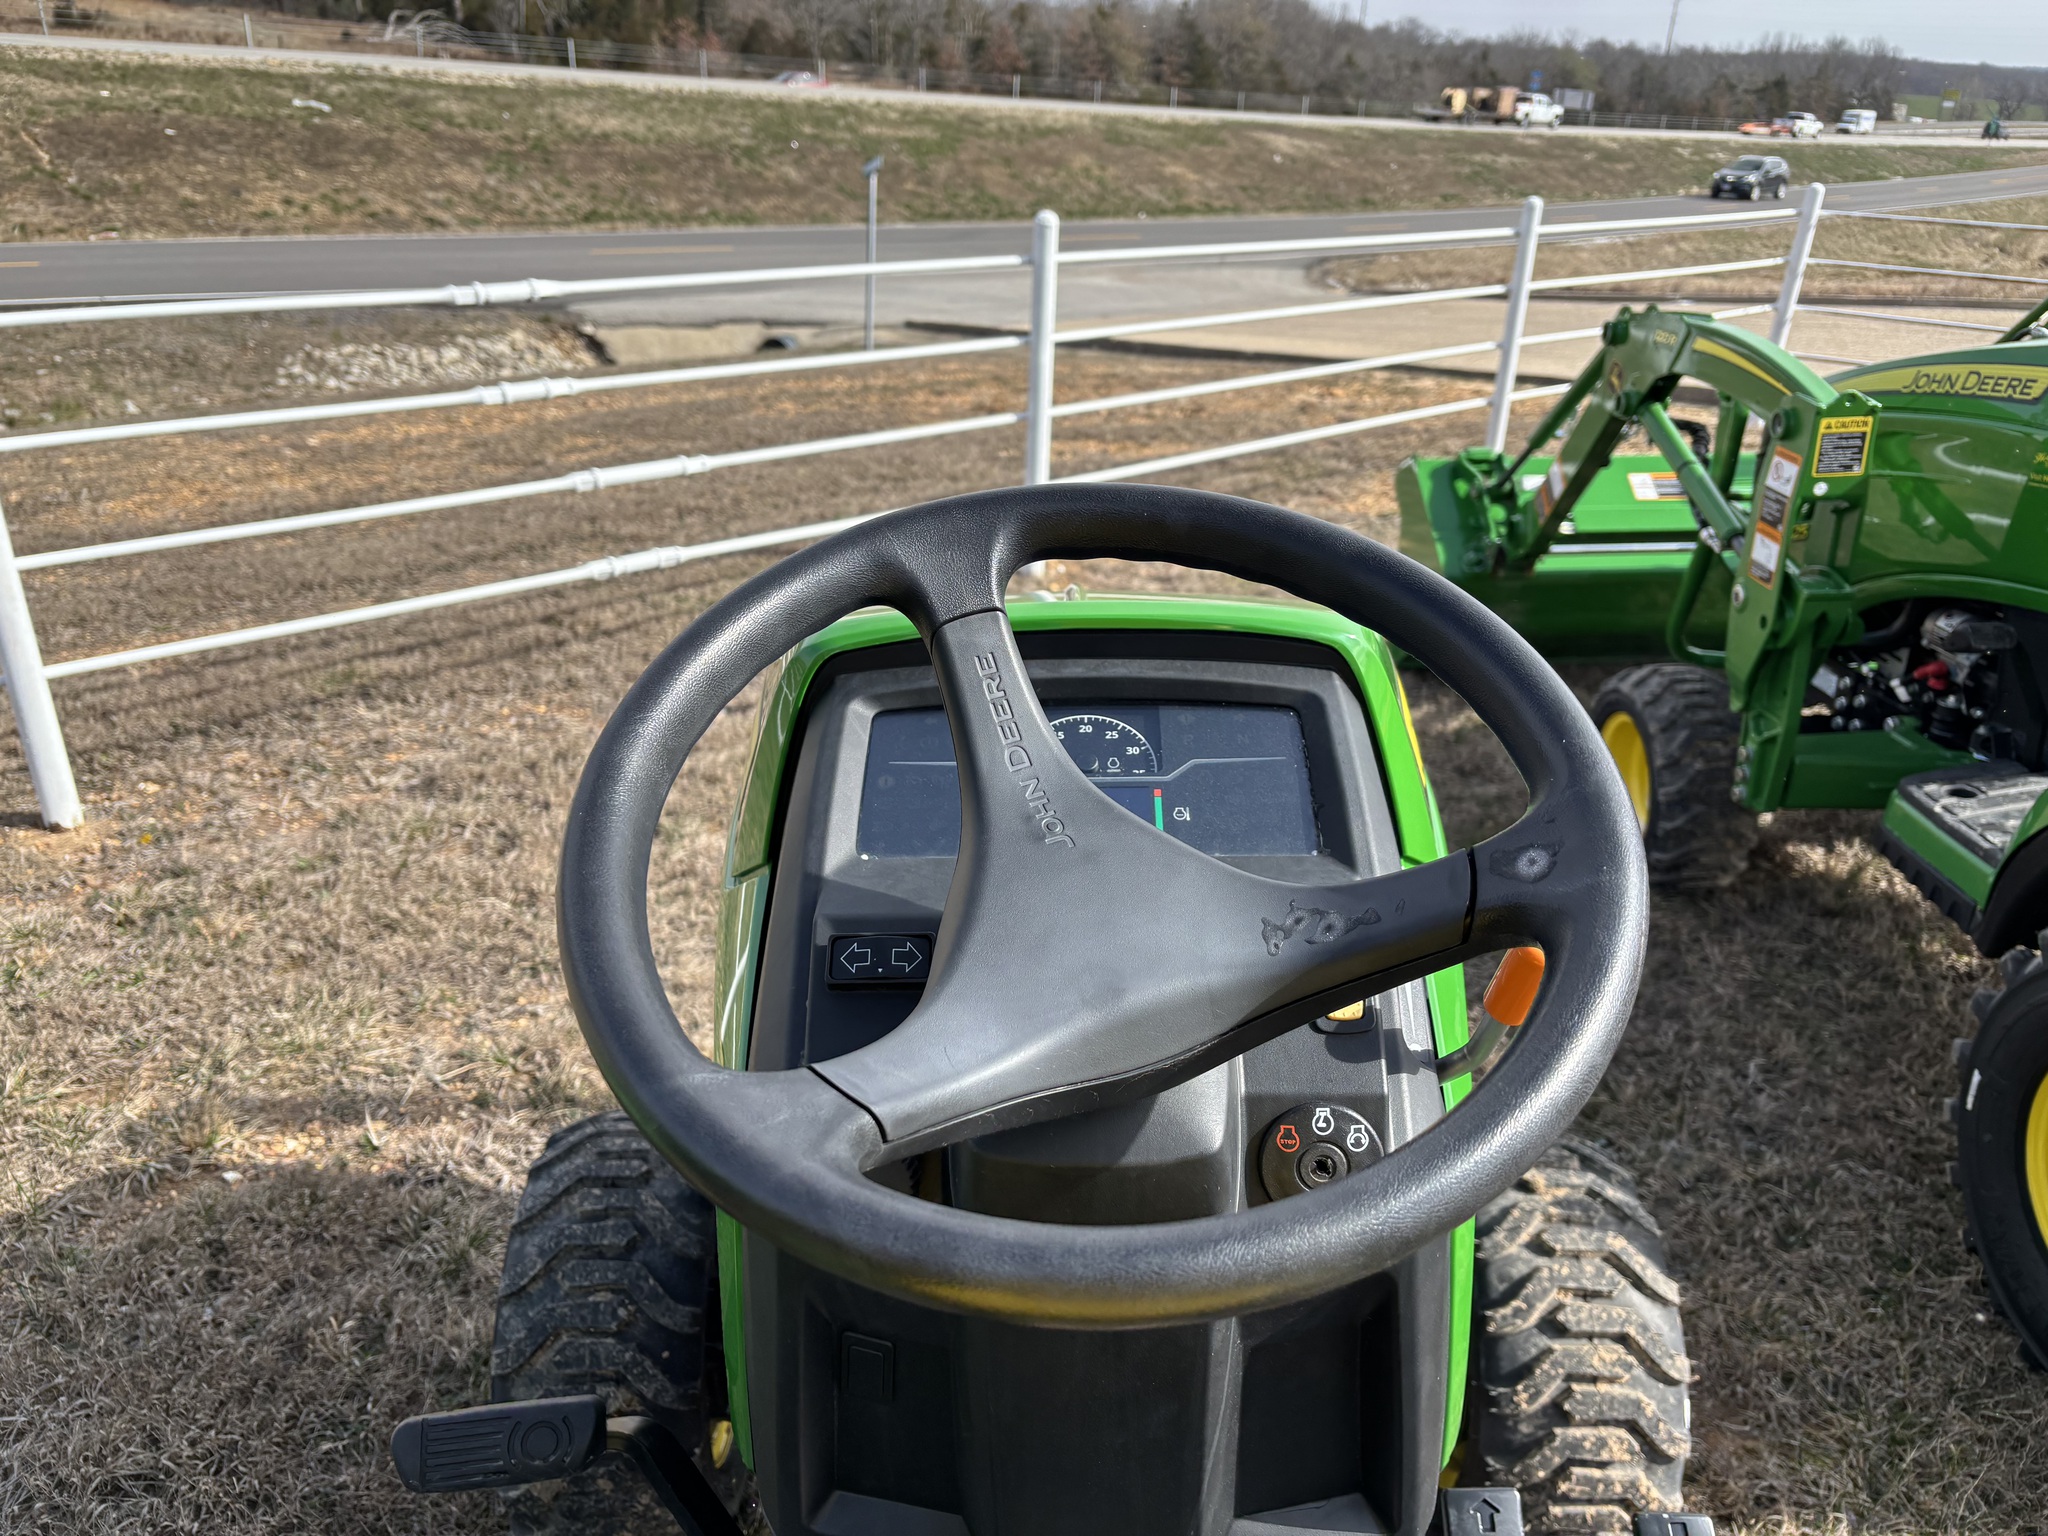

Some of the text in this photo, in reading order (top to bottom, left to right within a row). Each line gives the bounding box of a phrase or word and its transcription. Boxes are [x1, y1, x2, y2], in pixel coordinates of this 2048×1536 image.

[1902, 370, 2038, 397] JOHN DEERE
[1078, 724, 1093, 733] 20
[1055, 731, 1065, 740] 5
[1105, 730, 1119, 739] 25
[974, 651, 1075, 849] JOHN DEERE
[1125, 746, 1140, 755] 30
